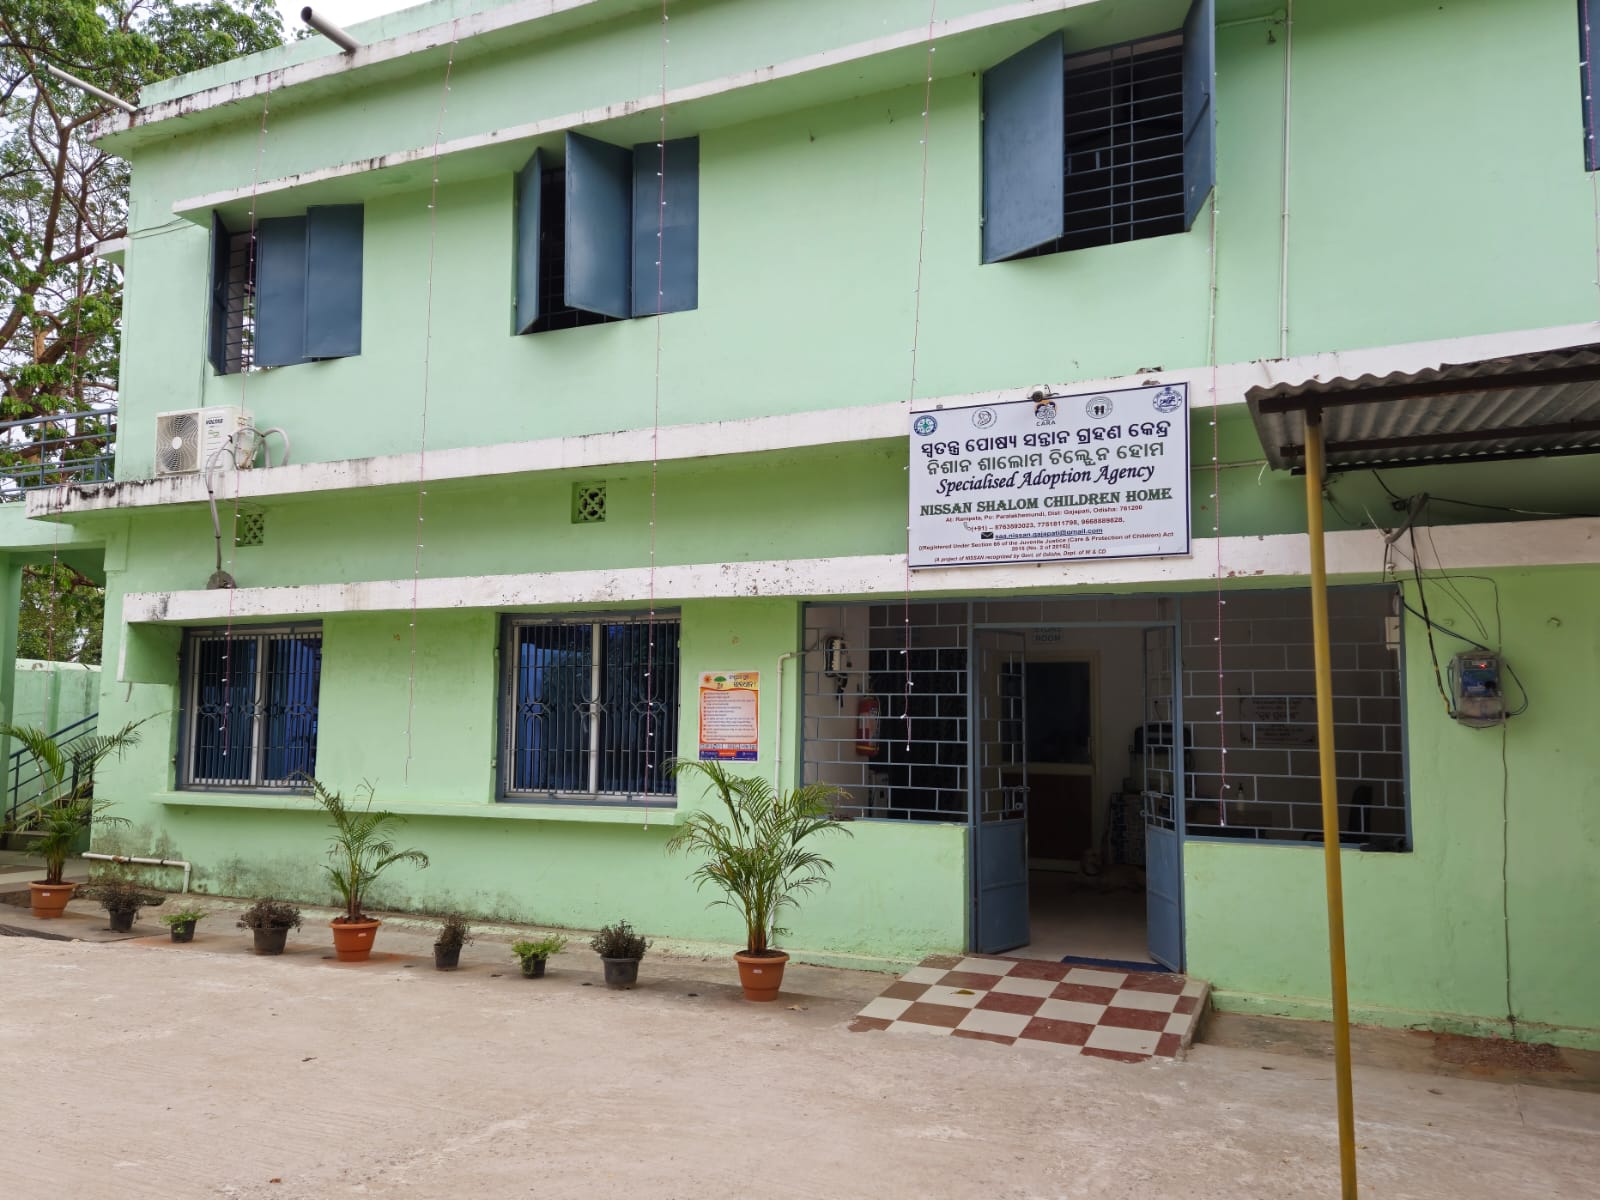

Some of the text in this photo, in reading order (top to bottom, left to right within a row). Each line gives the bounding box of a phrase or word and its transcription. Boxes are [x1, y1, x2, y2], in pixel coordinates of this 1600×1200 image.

[1023, 430, 1070, 447] ସନ୍ତାନ
[1076, 425, 1121, 444] ଗ୍ରହଣ
[1128, 420, 1171, 437] କେନ୍ଦ୍ର
[927, 459, 972, 475] ନିଶାନ
[977, 453, 1042, 471] ଶାଲୋମ
[1116, 442, 1164, 459] ହୋମ
[936, 464, 1155, 497] Specialised Adoption Agency
[920, 488, 1173, 516] NISSAN SHALOM CHILDREN HOME
